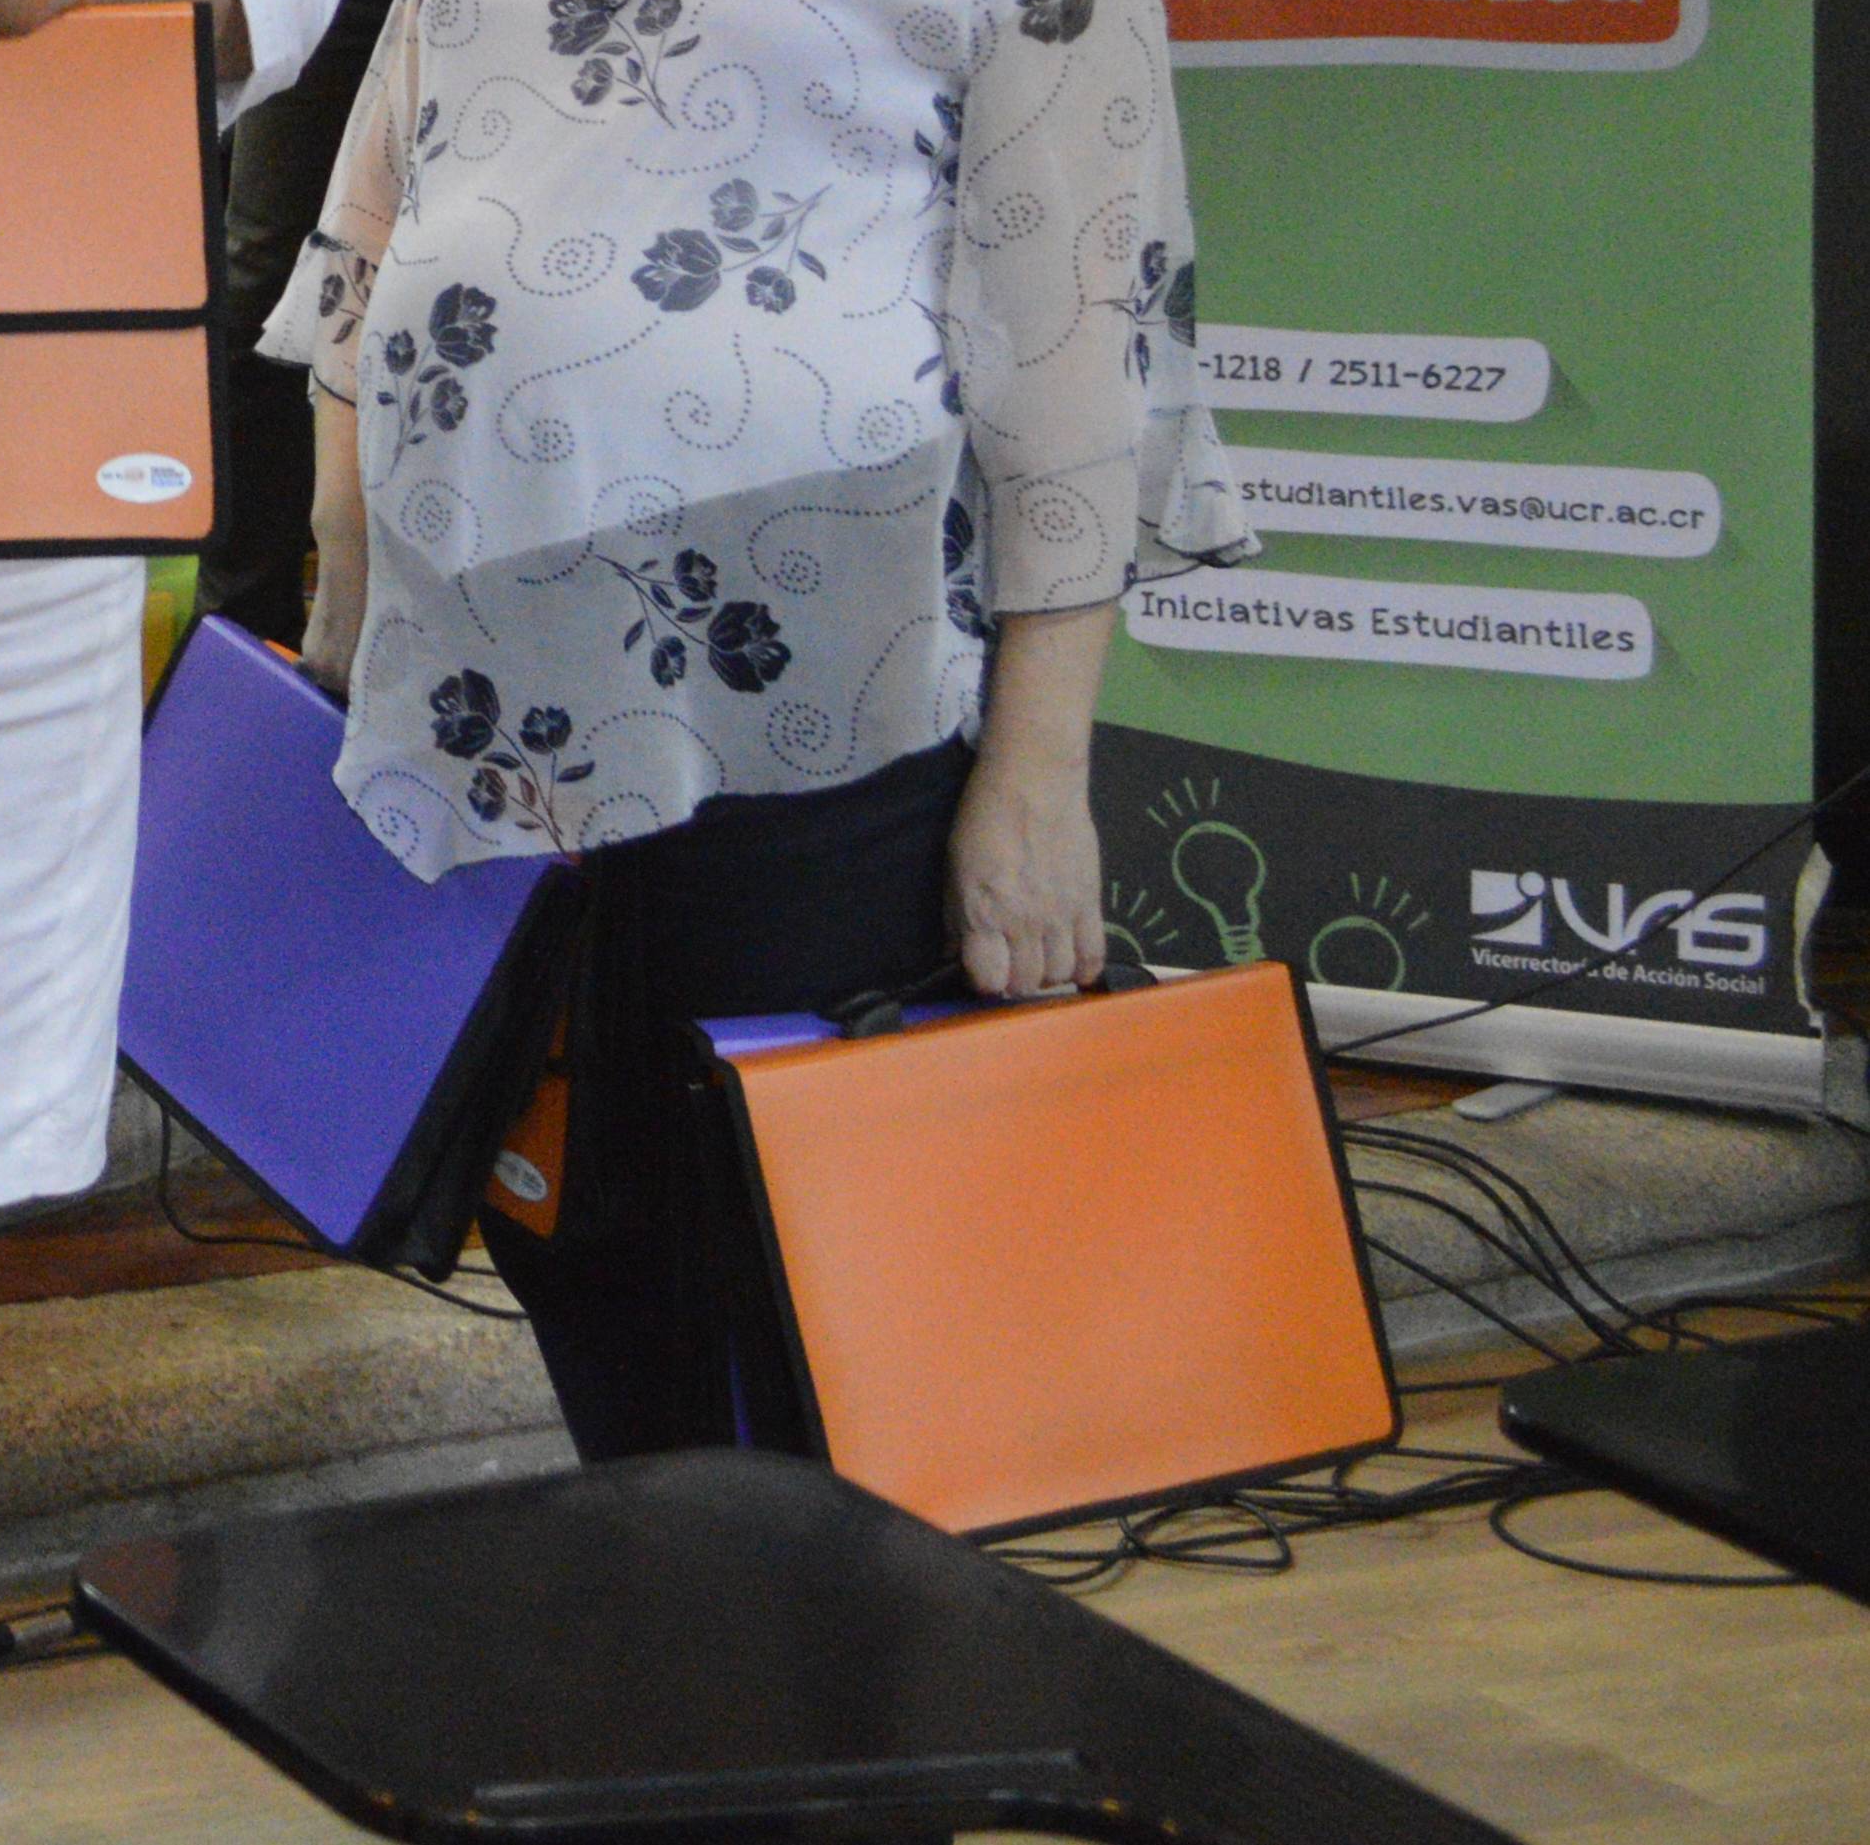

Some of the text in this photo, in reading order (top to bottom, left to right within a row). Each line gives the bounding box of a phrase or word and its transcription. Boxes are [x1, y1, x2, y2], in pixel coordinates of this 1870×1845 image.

[1328, 359, 1507, 392] 2511-6227
[1140, 590, 1636, 653] Iniciativas Estudiantiles
[1603, 962, 1628, 981] de
[1633, 963, 1700, 989] Acción
[1704, 971, 1765, 995] Social
